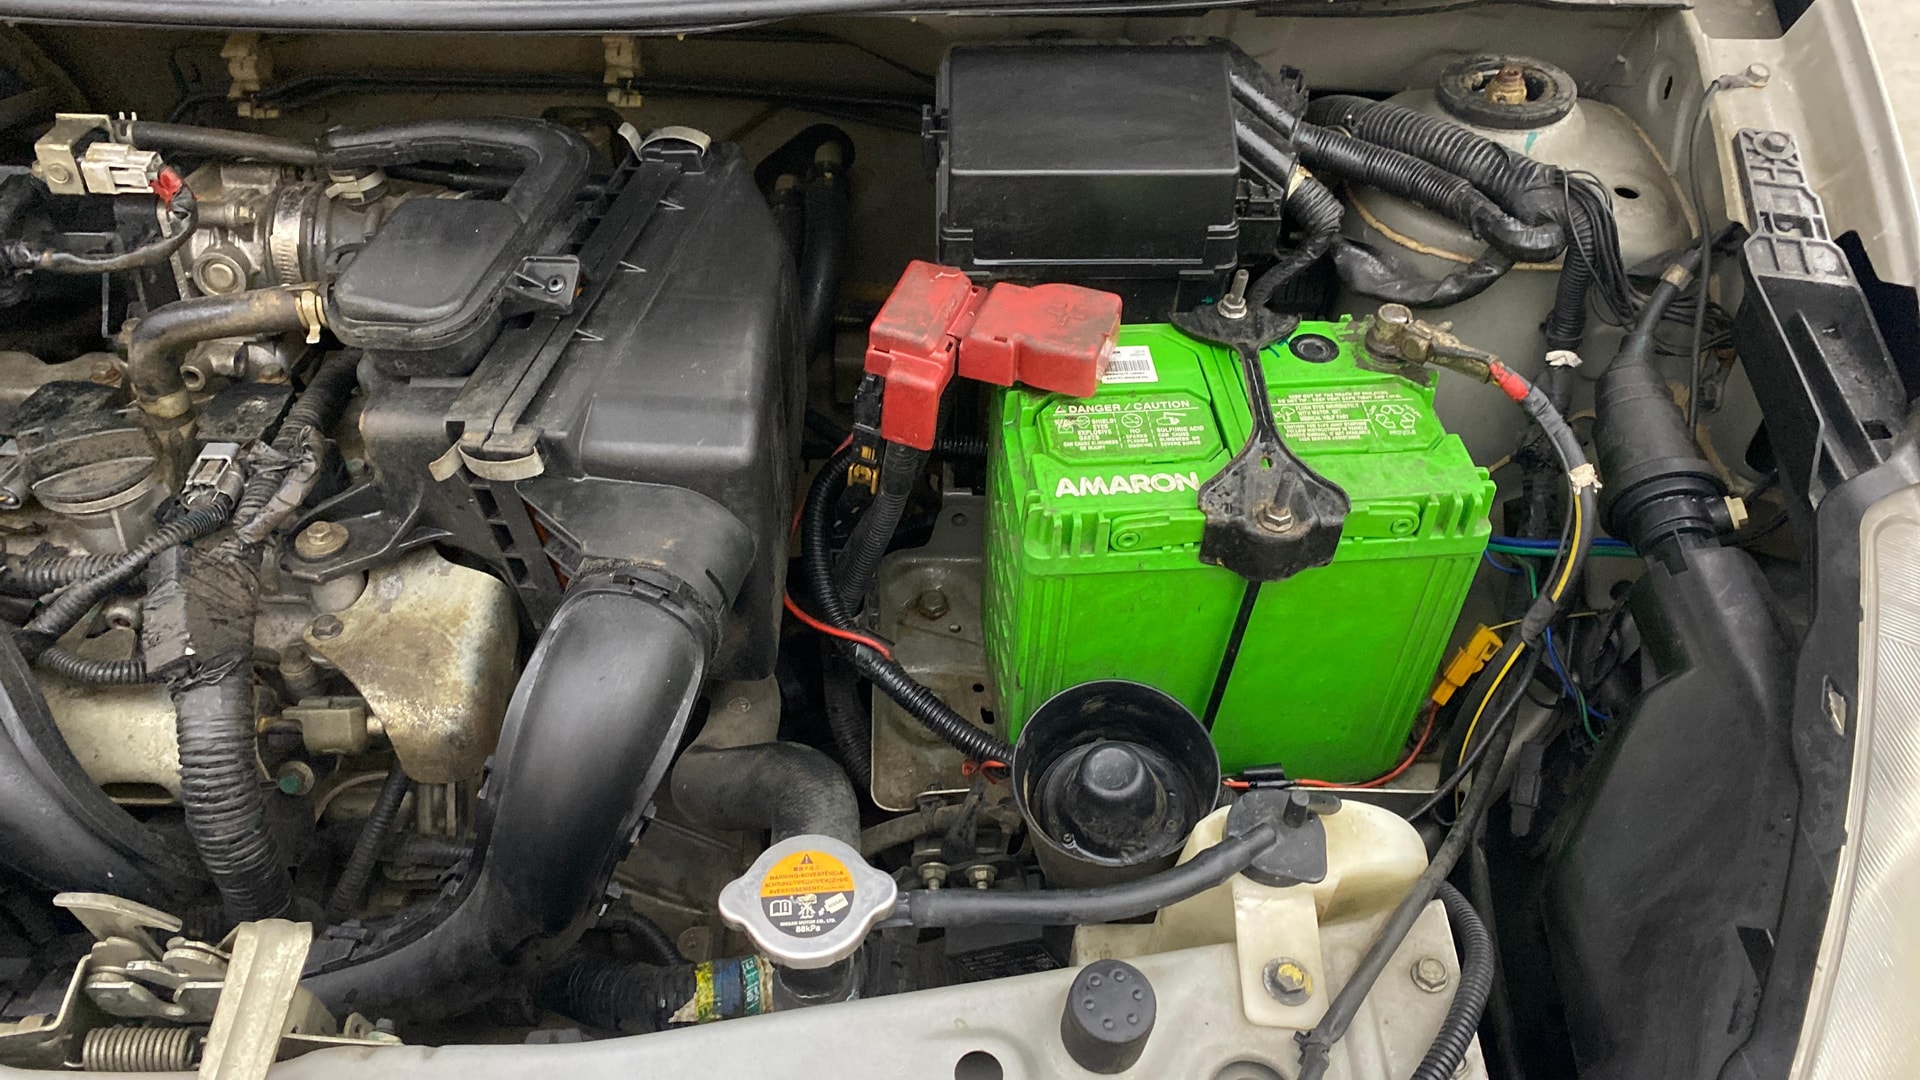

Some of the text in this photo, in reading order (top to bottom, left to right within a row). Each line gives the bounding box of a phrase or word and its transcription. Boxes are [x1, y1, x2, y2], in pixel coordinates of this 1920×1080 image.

[1068, 403, 1121, 413] DANGER
[1133, 400, 1190, 411] CAUTION
[1055, 471, 1200, 498] AMARON
